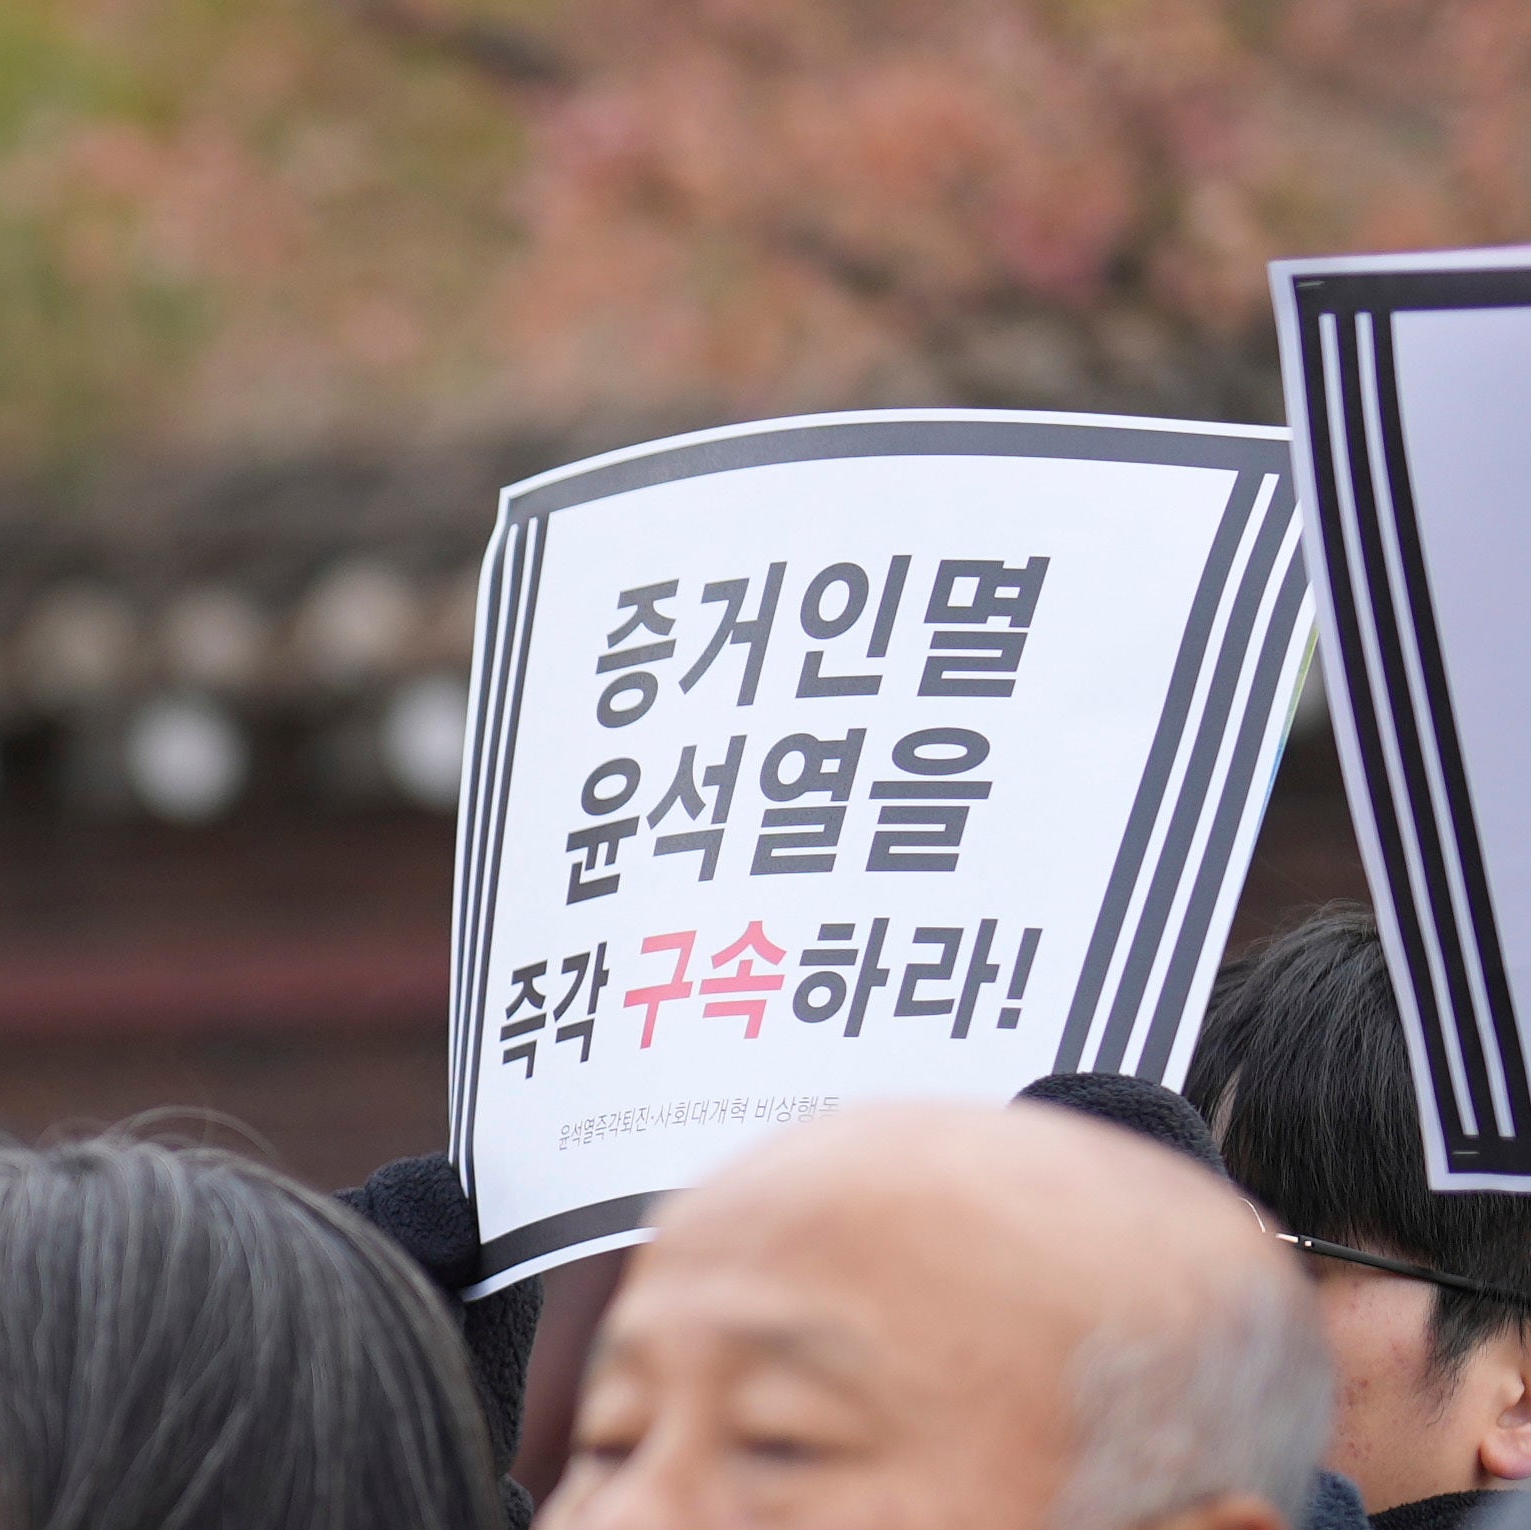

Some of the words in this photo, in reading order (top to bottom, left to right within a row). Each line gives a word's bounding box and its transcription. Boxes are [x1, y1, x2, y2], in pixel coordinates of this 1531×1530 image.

[595, 554, 1051, 730] 증거인멸
[564, 726, 995, 907] 윤석열을
[498, 941, 611, 1080] 즉각
[622, 916, 1044, 1051] 구속하라!
